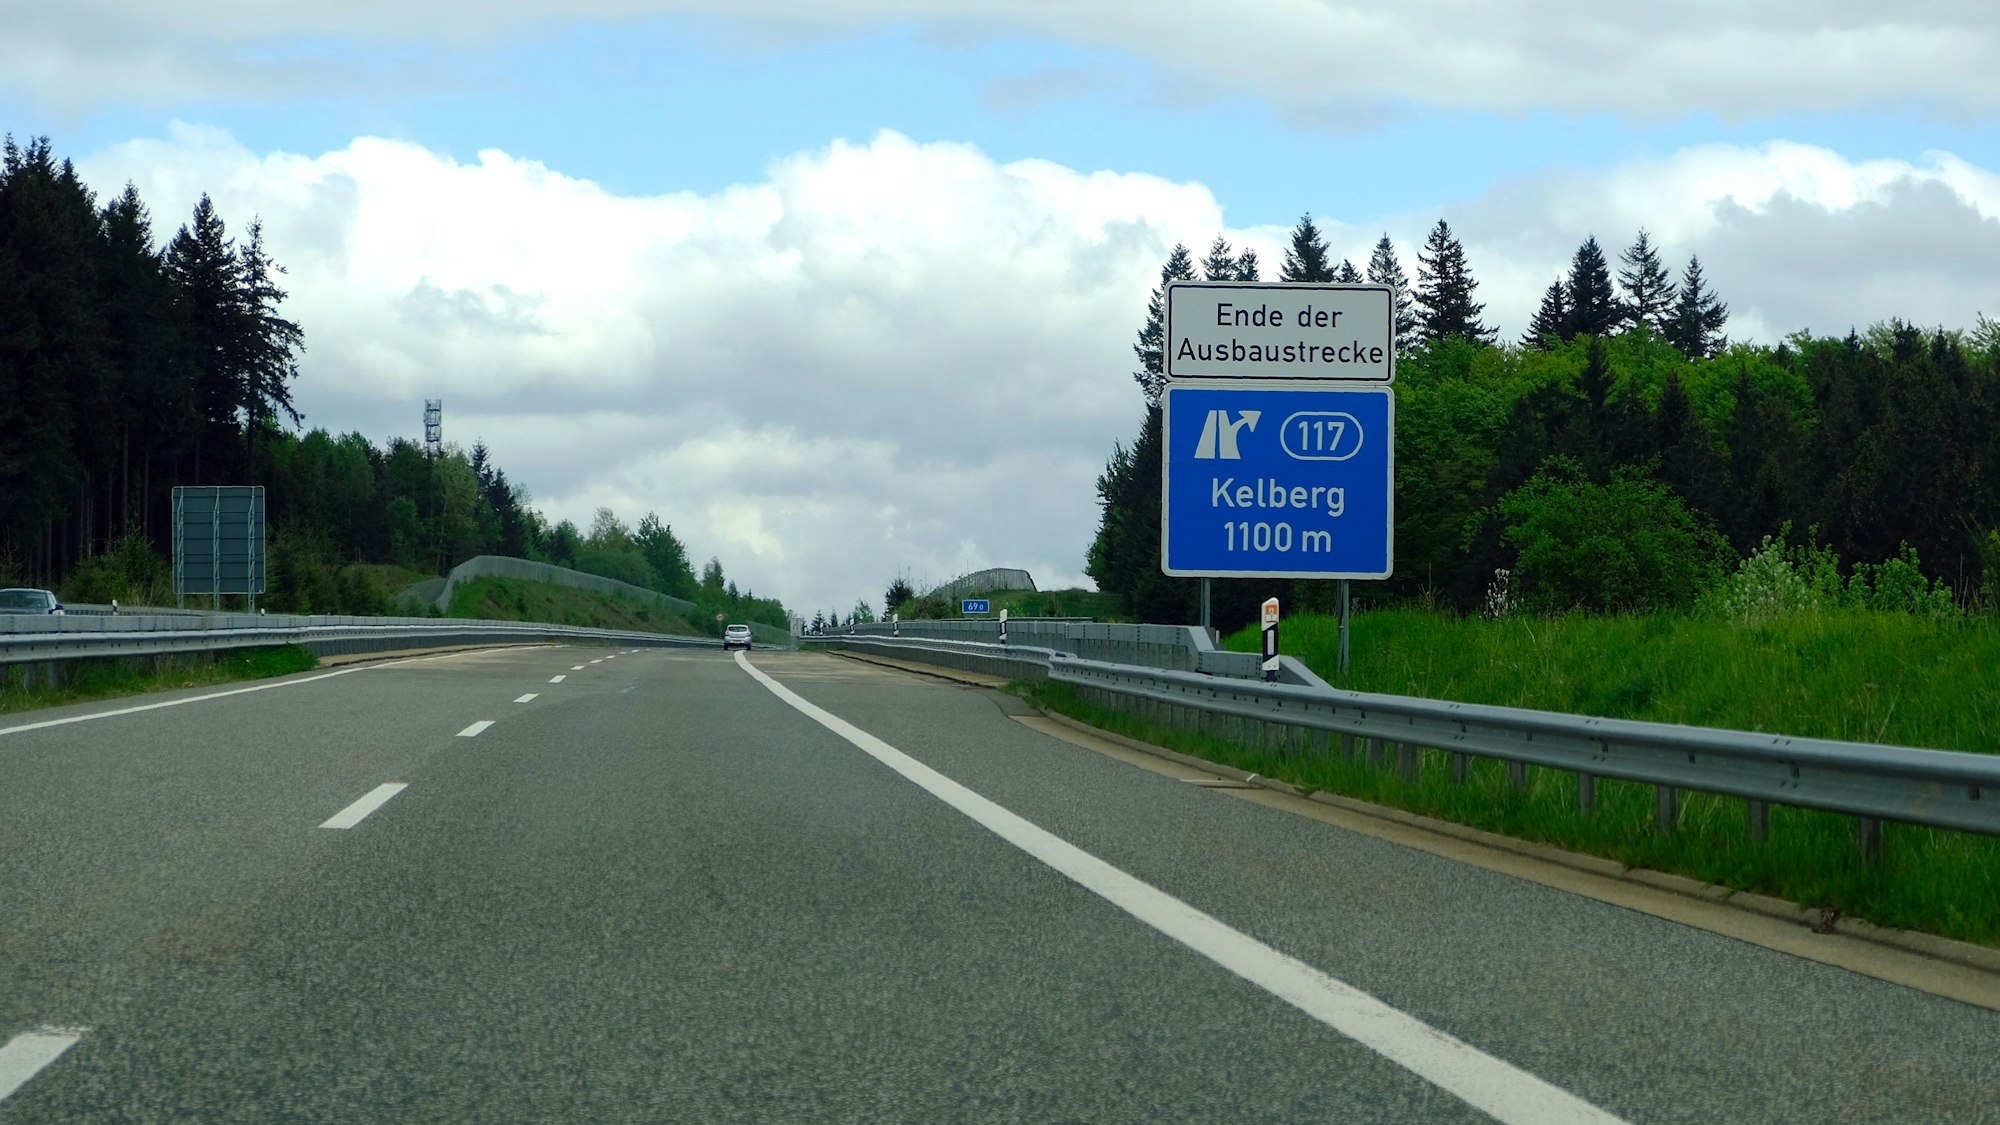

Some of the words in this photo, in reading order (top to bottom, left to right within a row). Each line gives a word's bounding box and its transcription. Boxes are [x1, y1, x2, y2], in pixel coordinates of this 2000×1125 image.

[1217, 303, 1283, 327] Ende
[1298, 305, 1343, 328] der
[1177, 338, 1384, 364] Ausbaustrecke
[1298, 421, 1345, 451] 117
[1212, 478, 1345, 517] Kelberg
[1224, 521, 1292, 552] 1100
[1302, 530, 1332, 553] m
